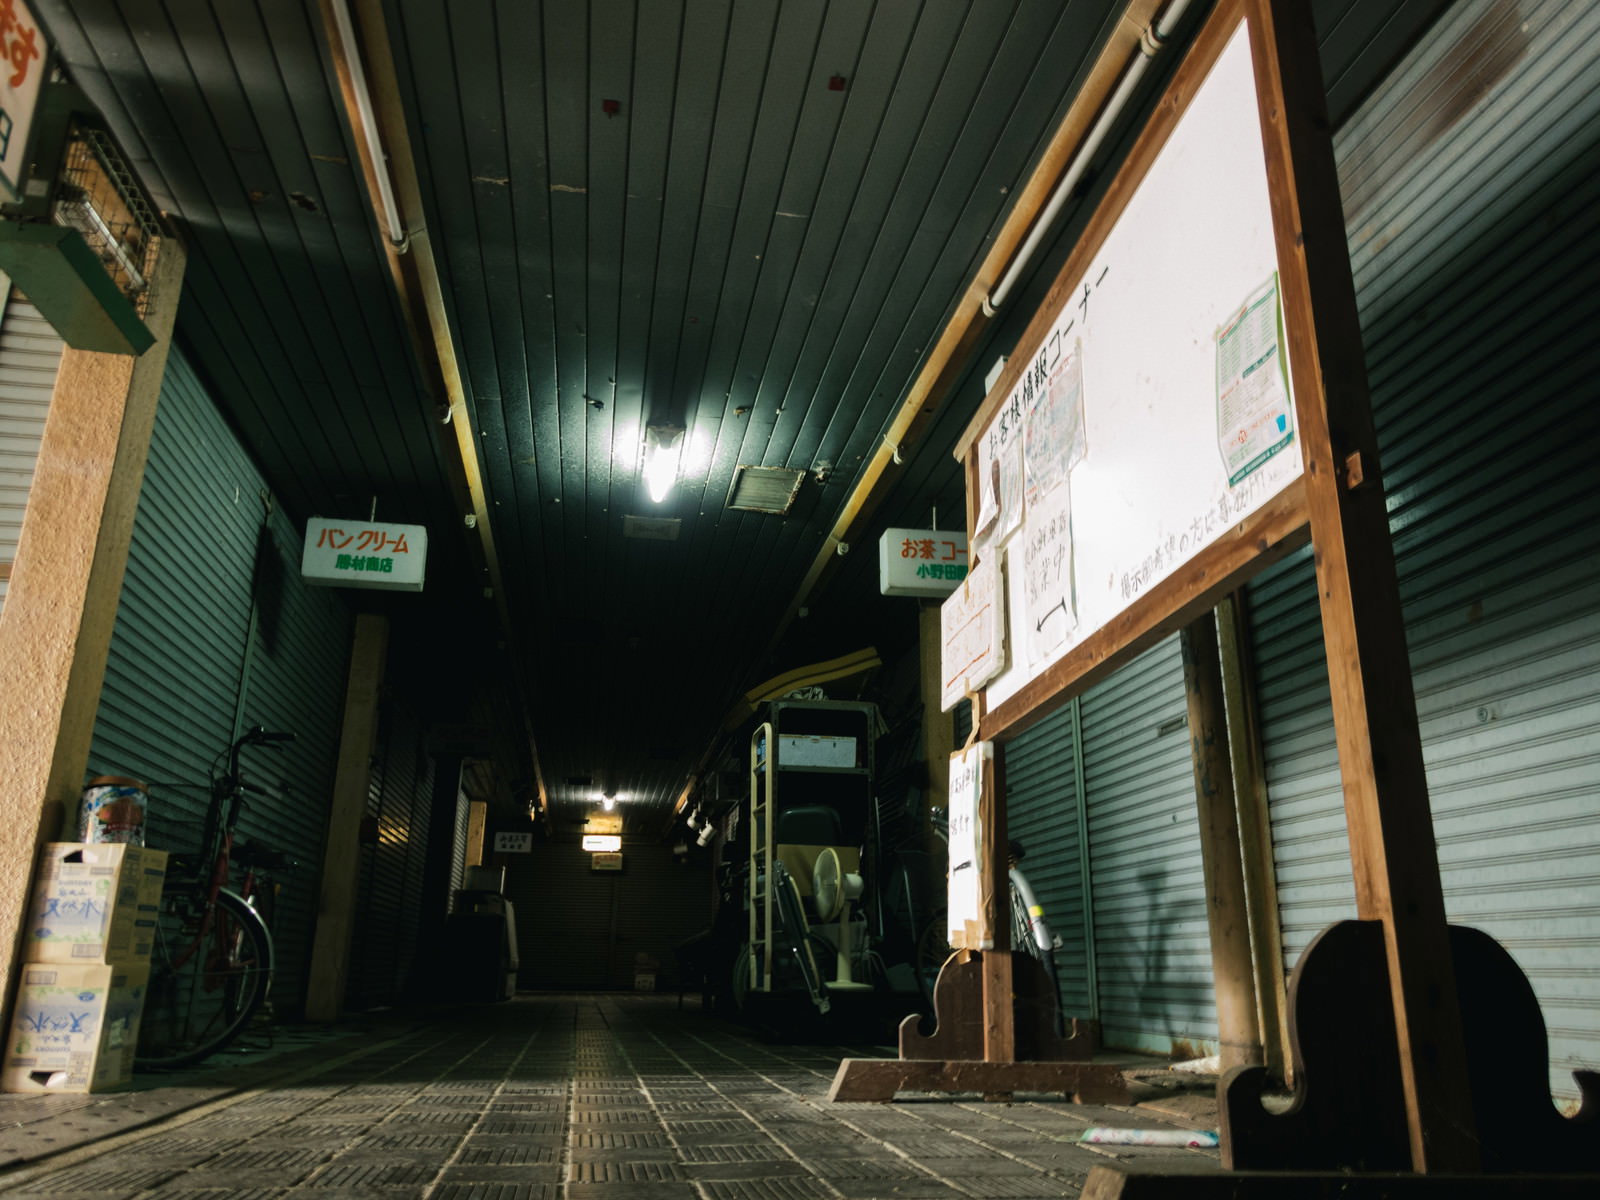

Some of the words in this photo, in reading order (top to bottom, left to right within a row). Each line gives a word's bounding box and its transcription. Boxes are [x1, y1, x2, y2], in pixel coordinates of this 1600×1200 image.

[40, 897, 101, 919] 天然水
[26, 1012, 90, 1033] 天然水
